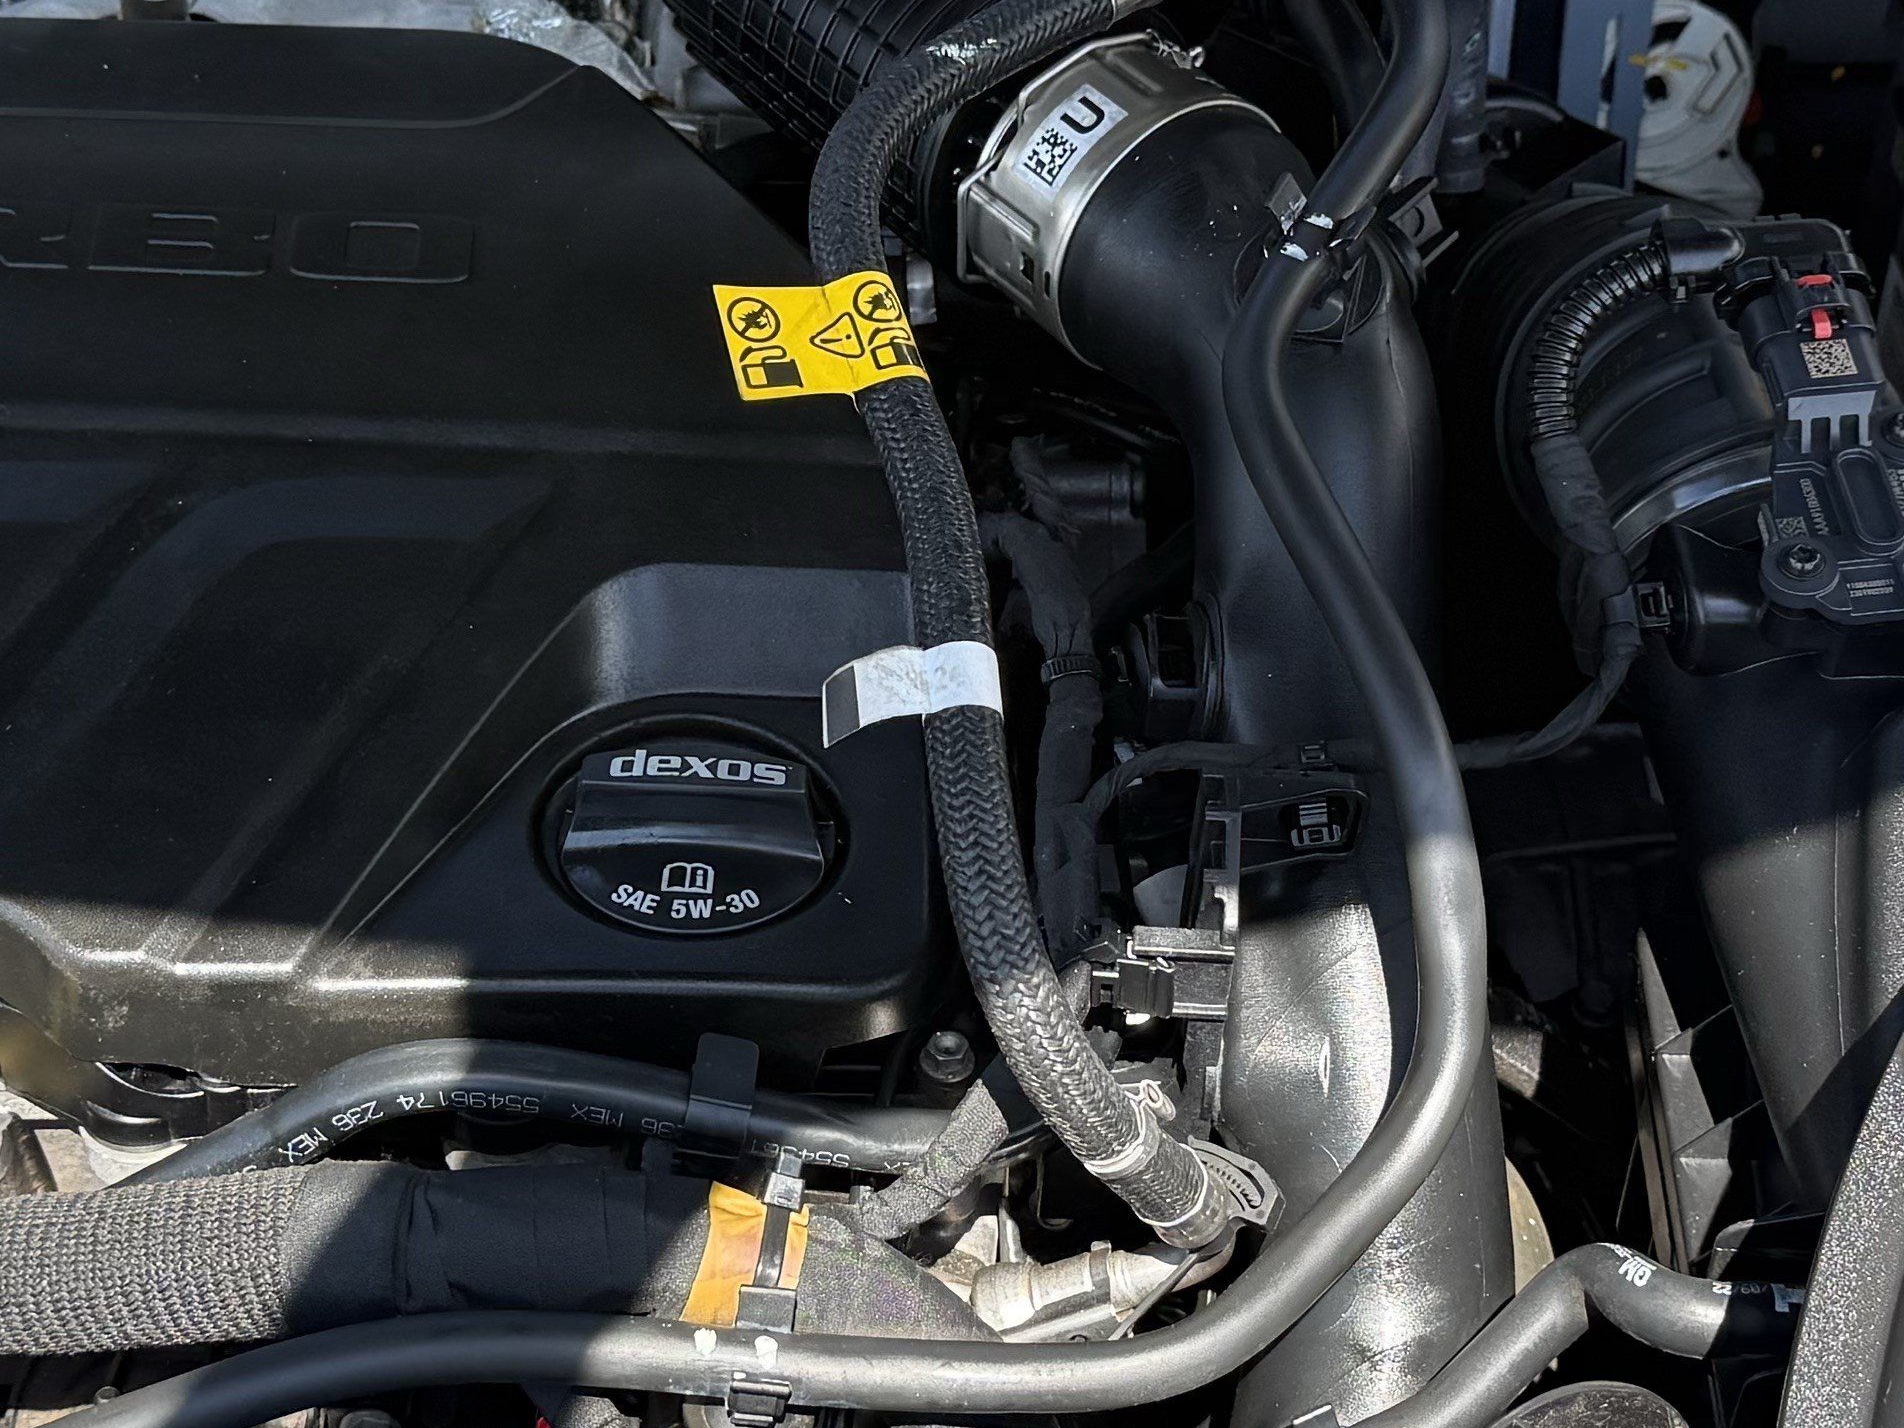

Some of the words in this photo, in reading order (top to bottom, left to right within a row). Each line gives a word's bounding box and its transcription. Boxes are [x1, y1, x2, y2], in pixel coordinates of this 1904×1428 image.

[1060, 96, 1105, 134] U
[609, 749, 786, 786] dexos
[611, 884, 661, 915] SAE
[671, 889, 760, 919] 5W-30
[396, 1090, 541, 1115] 55496174
[570, 1103, 625, 1129] MEX
[277, 1132, 329, 1163] MEX
